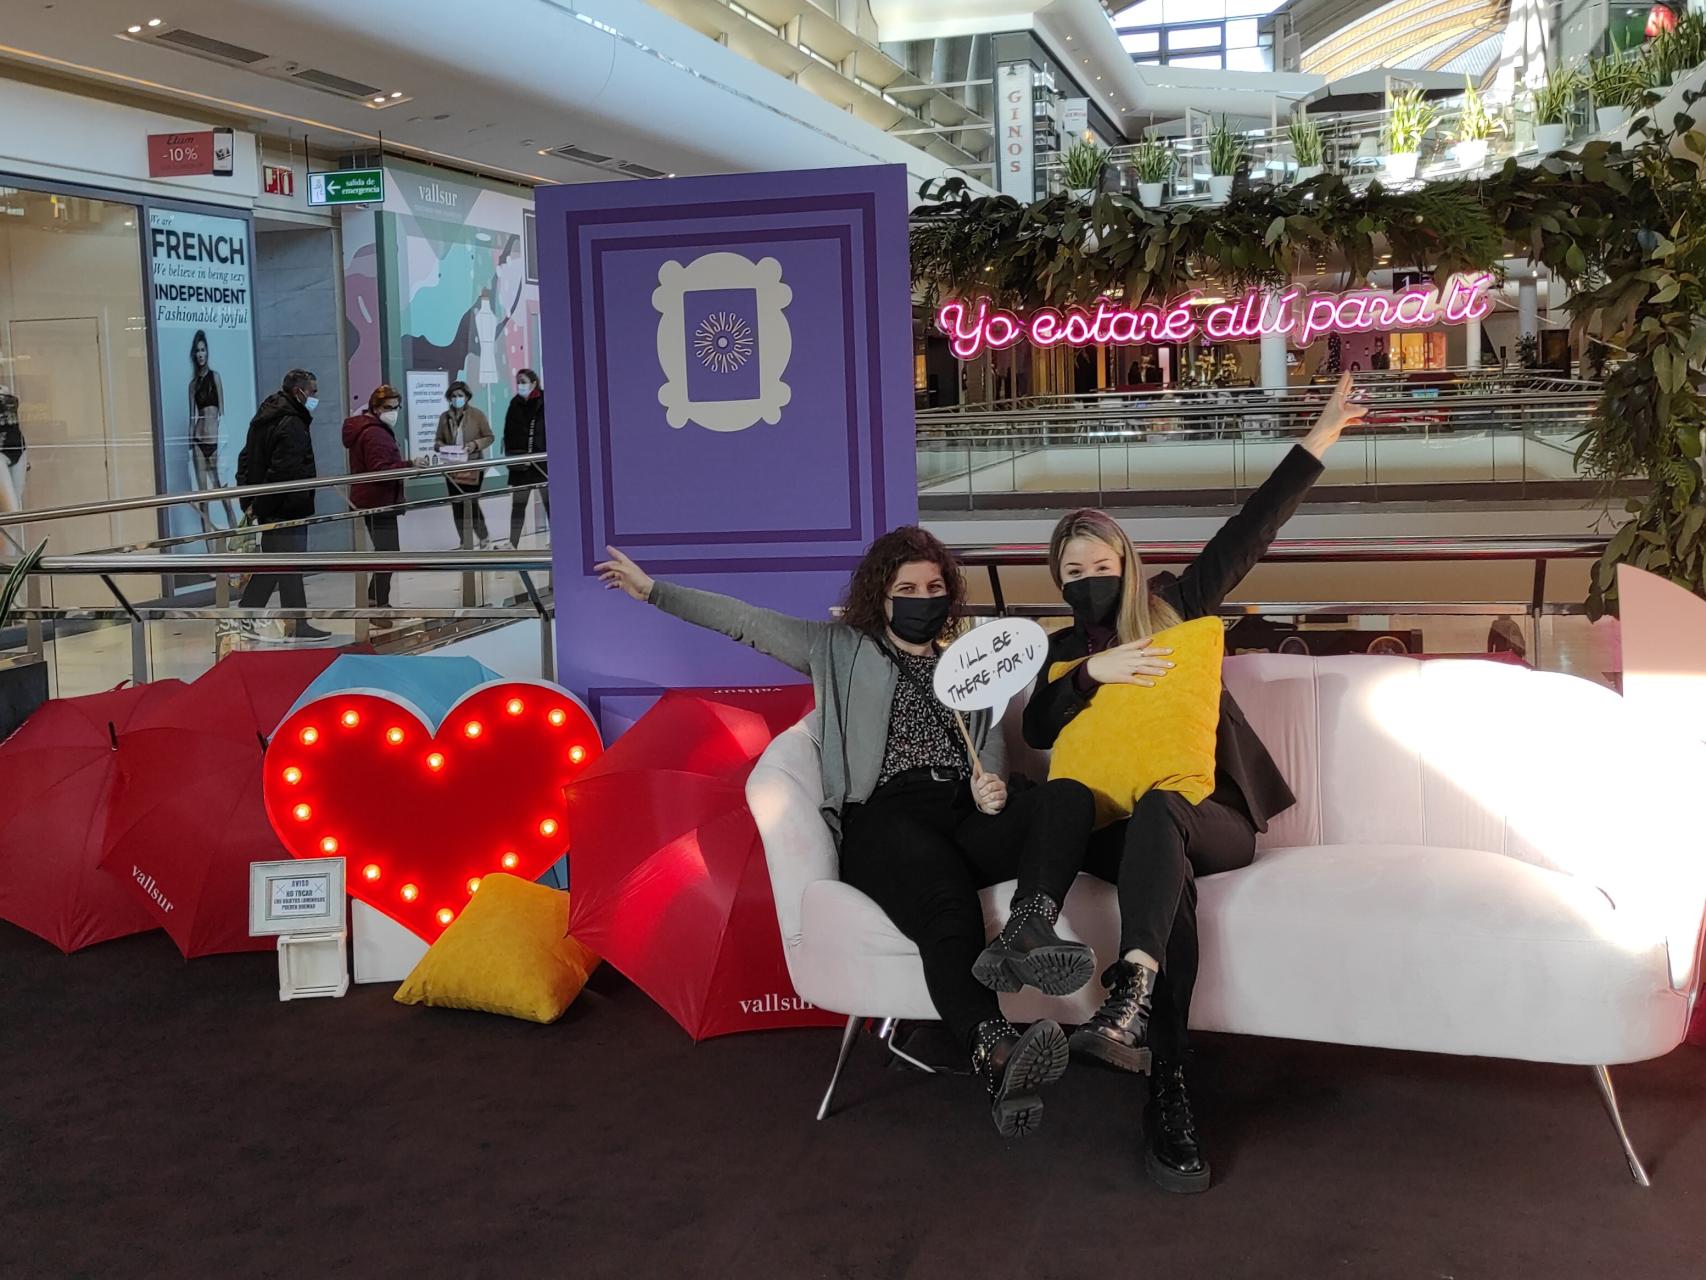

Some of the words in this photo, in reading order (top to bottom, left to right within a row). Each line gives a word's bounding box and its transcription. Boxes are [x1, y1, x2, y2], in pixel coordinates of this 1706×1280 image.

[1007, 90, 1022, 173] GINOS
[341, 186, 380, 196] emergencia
[345, 178, 365, 187] salida
[366, 177, 376, 186] de
[418, 183, 458, 207] vallsur
[150, 214, 160, 225] We
[162, 217, 172, 226] are
[151, 228, 245, 266] FRENCH
[153, 263, 166, 277] We
[168, 264, 195, 279] believe
[198, 265, 206, 279] in
[208, 266, 228, 285] being
[230, 272, 245, 286] sexy
[154, 283, 247, 305] INDEPENDENT
[158, 305, 217, 323] Fashionable
[219, 307, 248, 329] joyful
[939, 302, 1020, 357] Yo
[1031, 299, 1196, 345] estaré
[1206, 289, 1296, 338] allí
[1301, 290, 1435, 345] para
[992, 630, 1012, 653] BE
[947, 669, 991, 704] THERE
[996, 652, 1023, 679] FOR
[1025, 643, 1034, 661] U
[132, 864, 174, 913] vallsur
